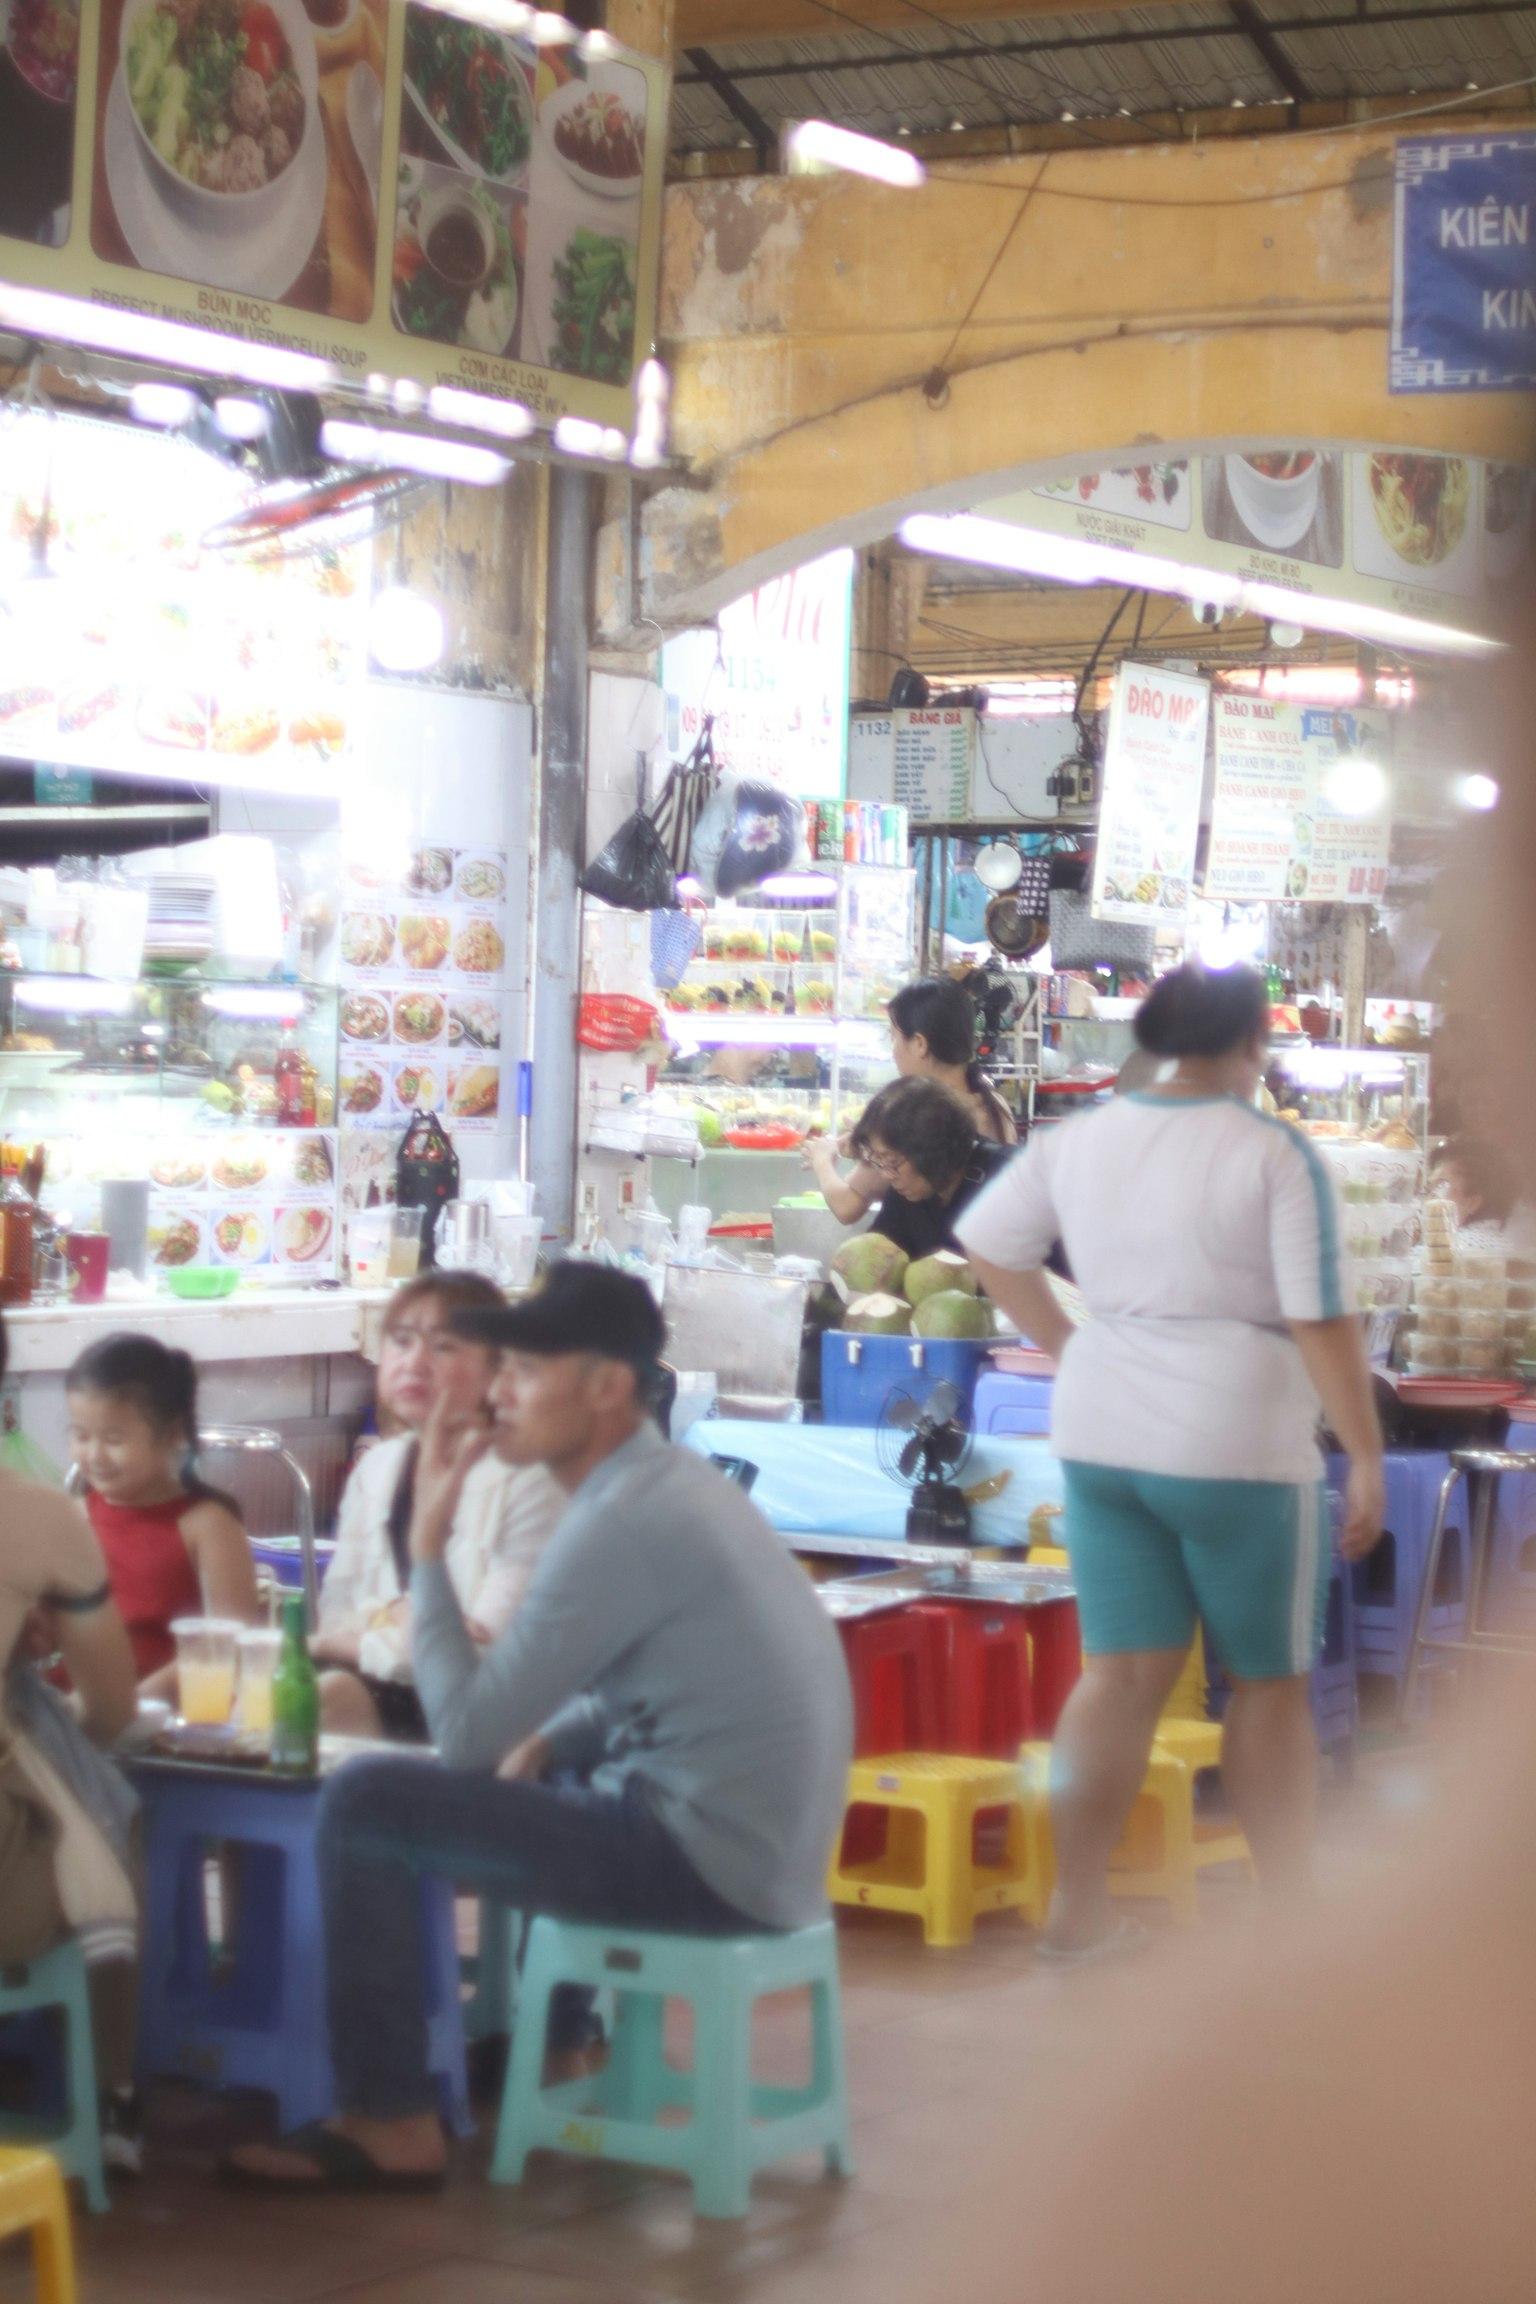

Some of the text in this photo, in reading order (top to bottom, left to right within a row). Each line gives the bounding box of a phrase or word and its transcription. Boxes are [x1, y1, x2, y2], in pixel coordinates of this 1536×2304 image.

[1440, 195, 1528, 248] KIÊN
[330, 345, 368, 369] SOUP
[857, 720, 893, 737] 1132
